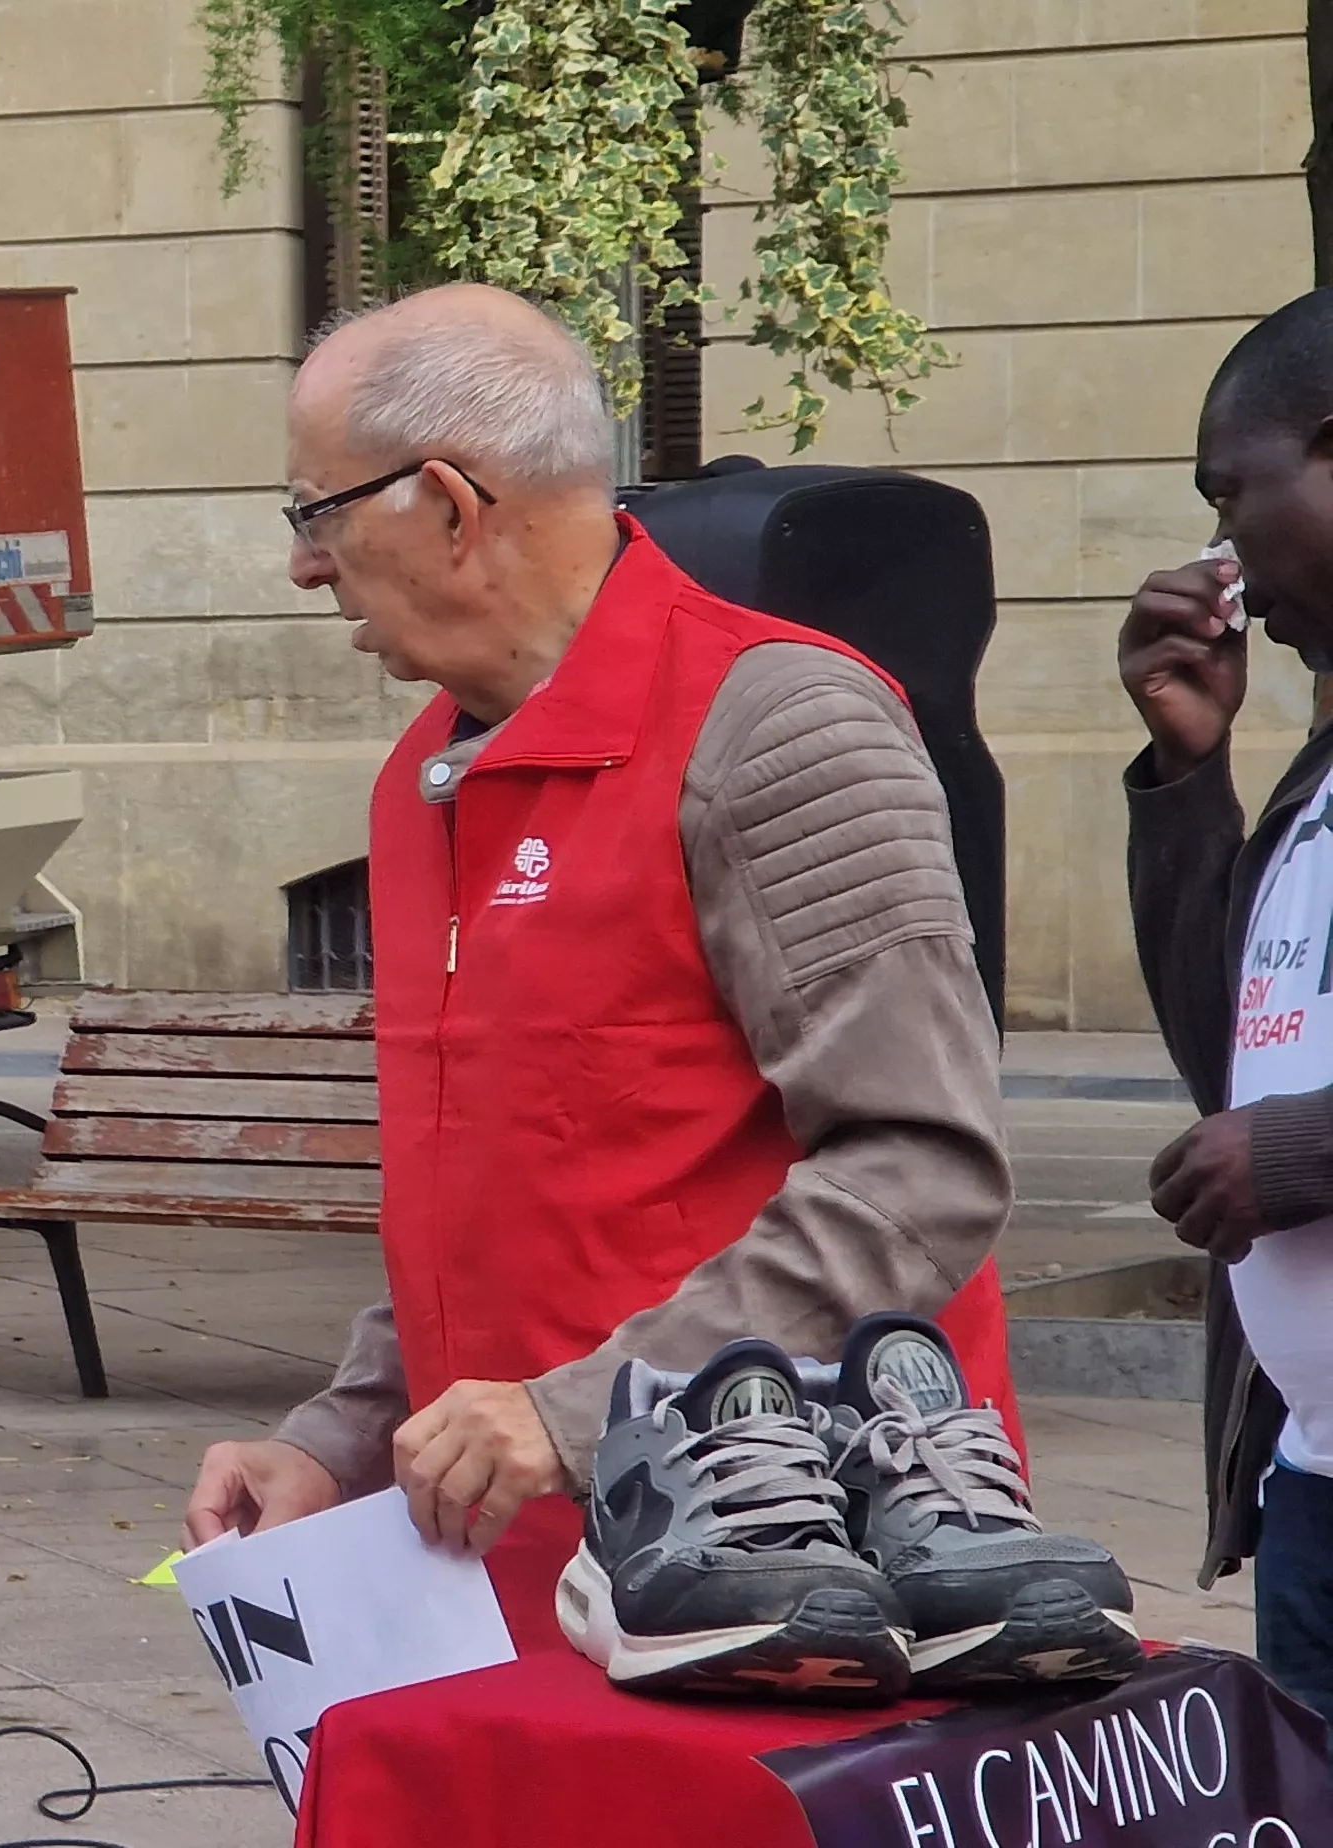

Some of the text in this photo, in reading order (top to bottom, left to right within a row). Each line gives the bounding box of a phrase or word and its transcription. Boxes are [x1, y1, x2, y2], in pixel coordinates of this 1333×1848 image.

[1252, 937, 1310, 970] NADIE
[1242, 976, 1273, 1009] SIN
[1236, 1009, 1304, 1050] HOGAR
[974, 1687, 1227, 1848] CAMINO
